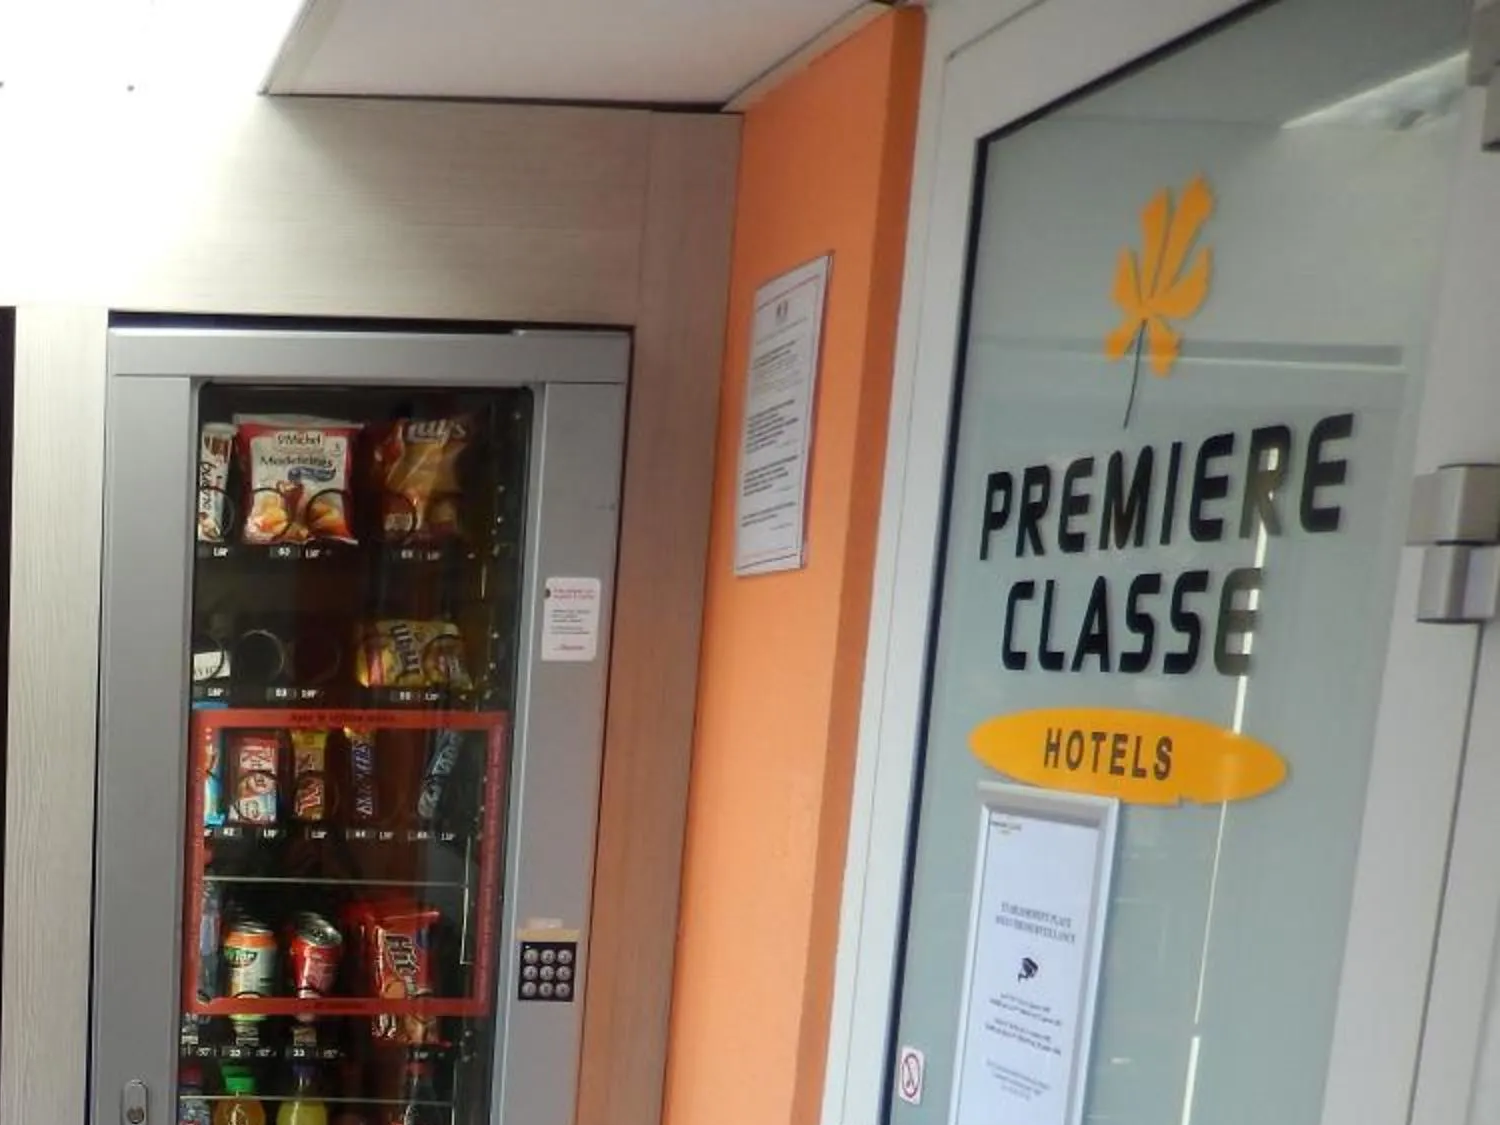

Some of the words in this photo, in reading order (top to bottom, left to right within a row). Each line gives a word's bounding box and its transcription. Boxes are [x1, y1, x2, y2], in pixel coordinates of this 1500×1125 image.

[979, 412, 1355, 561] PREMIERE
[1002, 567, 1263, 677] CLASSE
[1043, 727, 1174, 781] HOTELS
